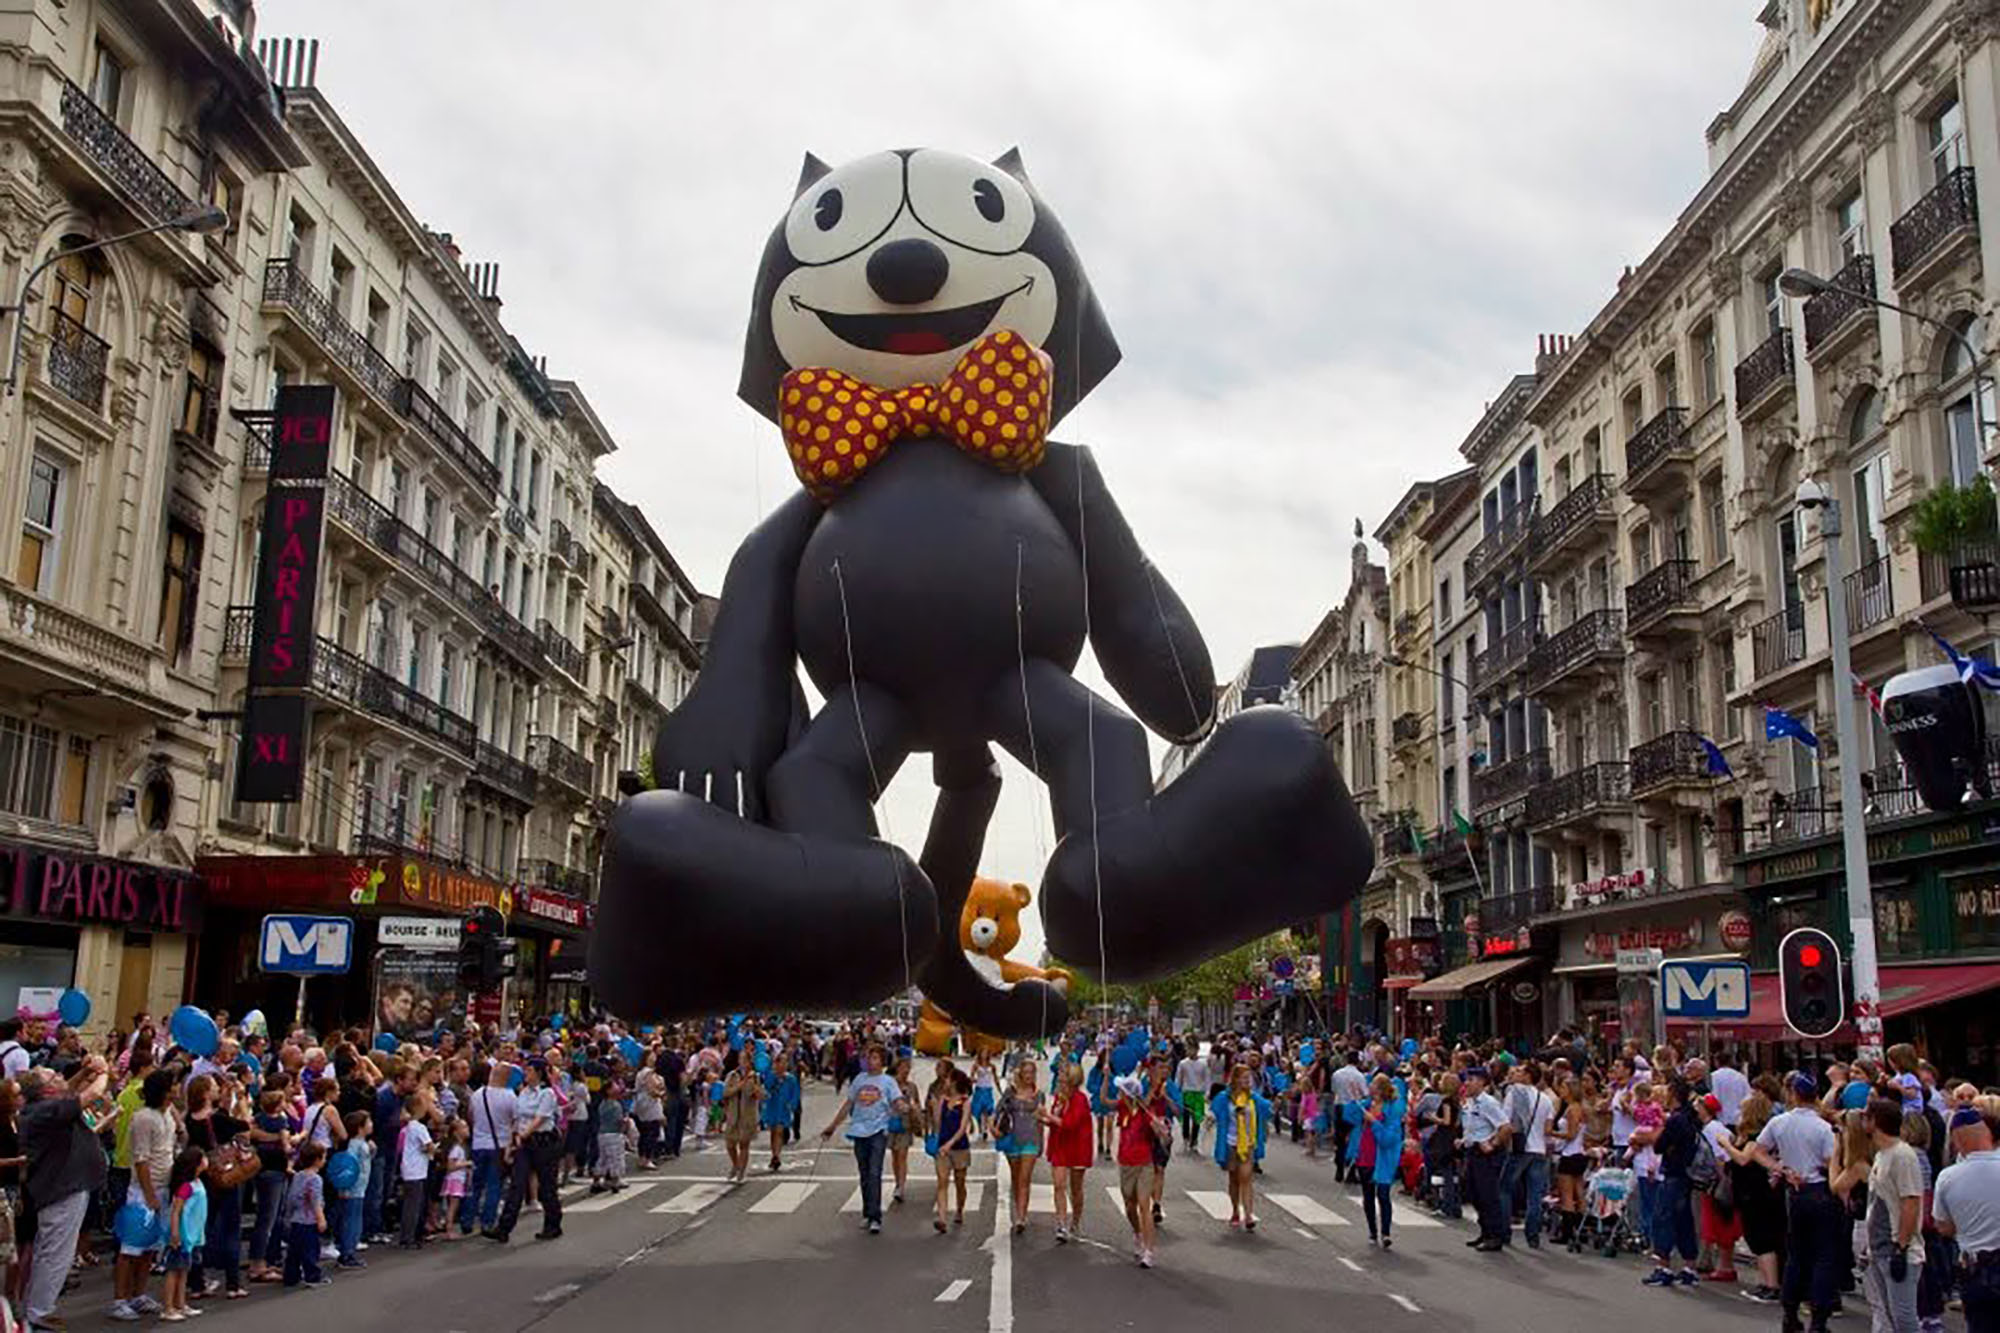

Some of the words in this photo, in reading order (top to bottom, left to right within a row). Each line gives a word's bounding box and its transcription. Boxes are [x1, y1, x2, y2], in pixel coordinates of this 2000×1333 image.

[281, 414, 328, 444] ICI
[269, 498, 308, 674] PARIS
[39, 854, 141, 922] PARIS
[150, 873, 184, 927] XI
[385, 925, 428, 937] BOURSE
